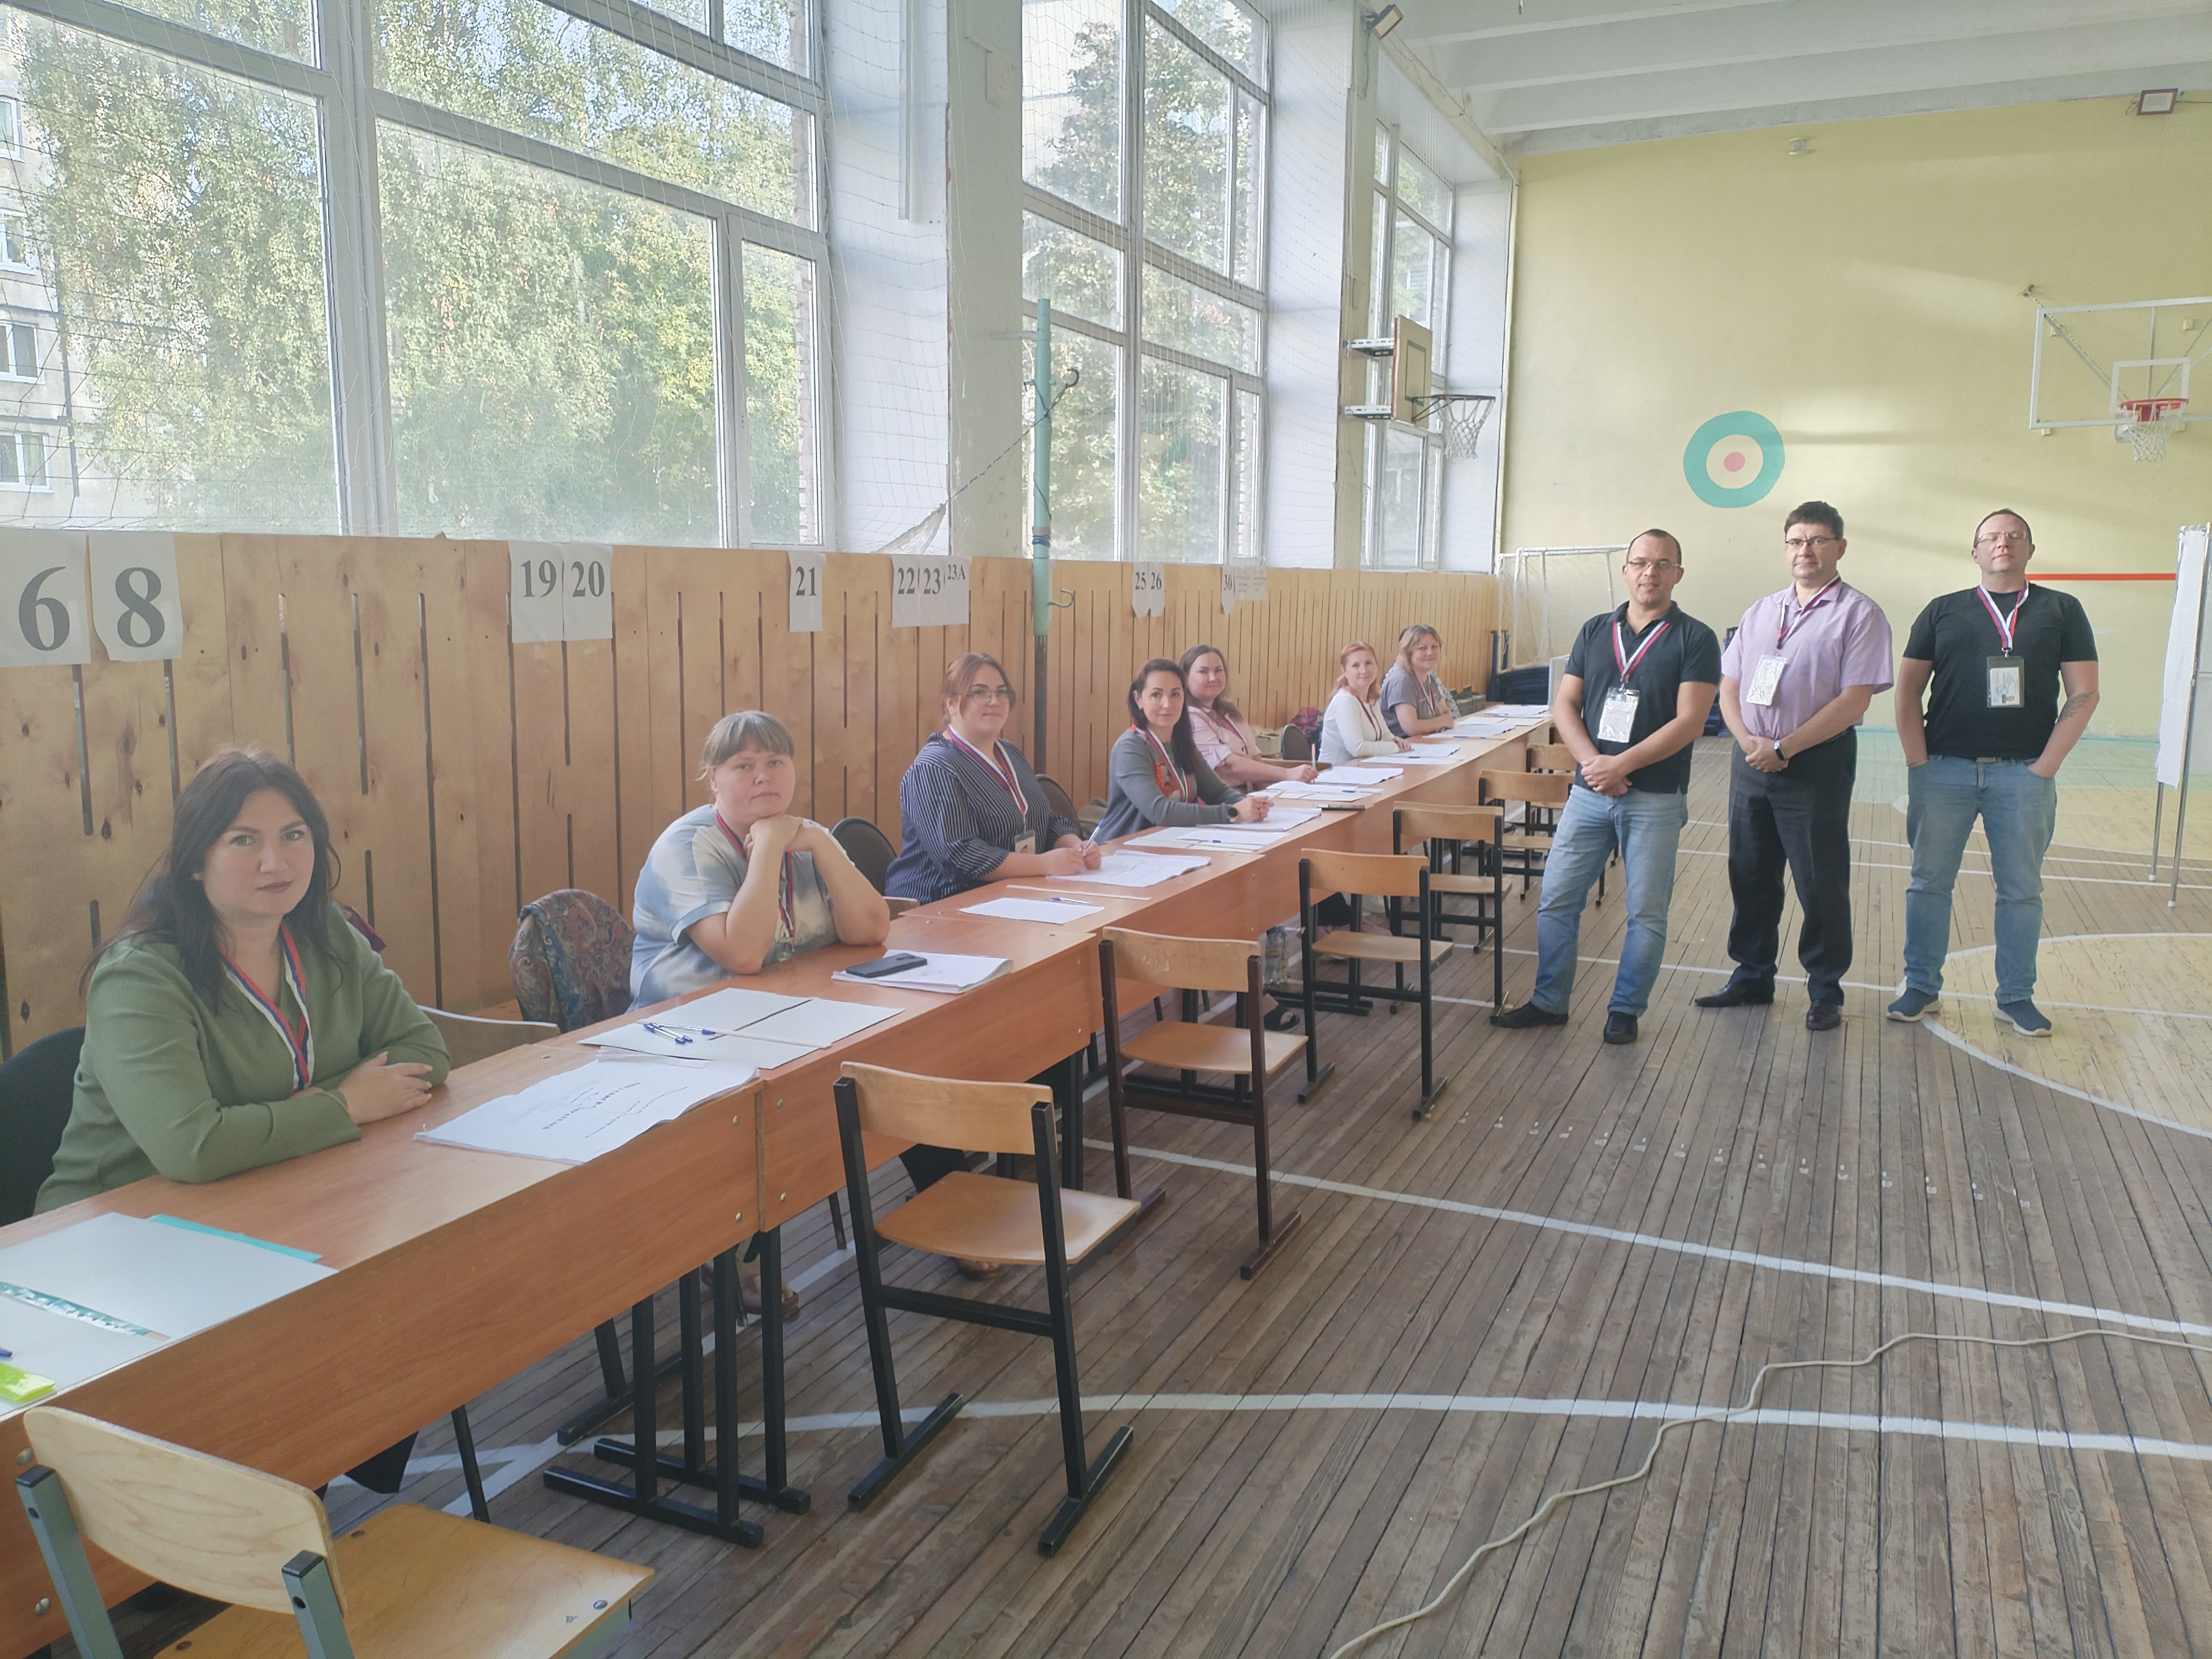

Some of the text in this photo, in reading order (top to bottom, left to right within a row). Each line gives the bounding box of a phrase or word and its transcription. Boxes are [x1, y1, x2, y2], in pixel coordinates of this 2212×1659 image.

[521, 559, 556, 597] 19
[571, 561, 605, 597] 20
[795, 566, 817, 596] 21
[897, 567, 915, 595] 22
[923, 568, 941, 595] 23
[1135, 572, 1147, 590] 25
[1150, 571, 1162, 590] 26
[1223, 574, 1232, 590] 30
[19, 566, 70, 651] 6
[115, 567, 165, 648] 8
